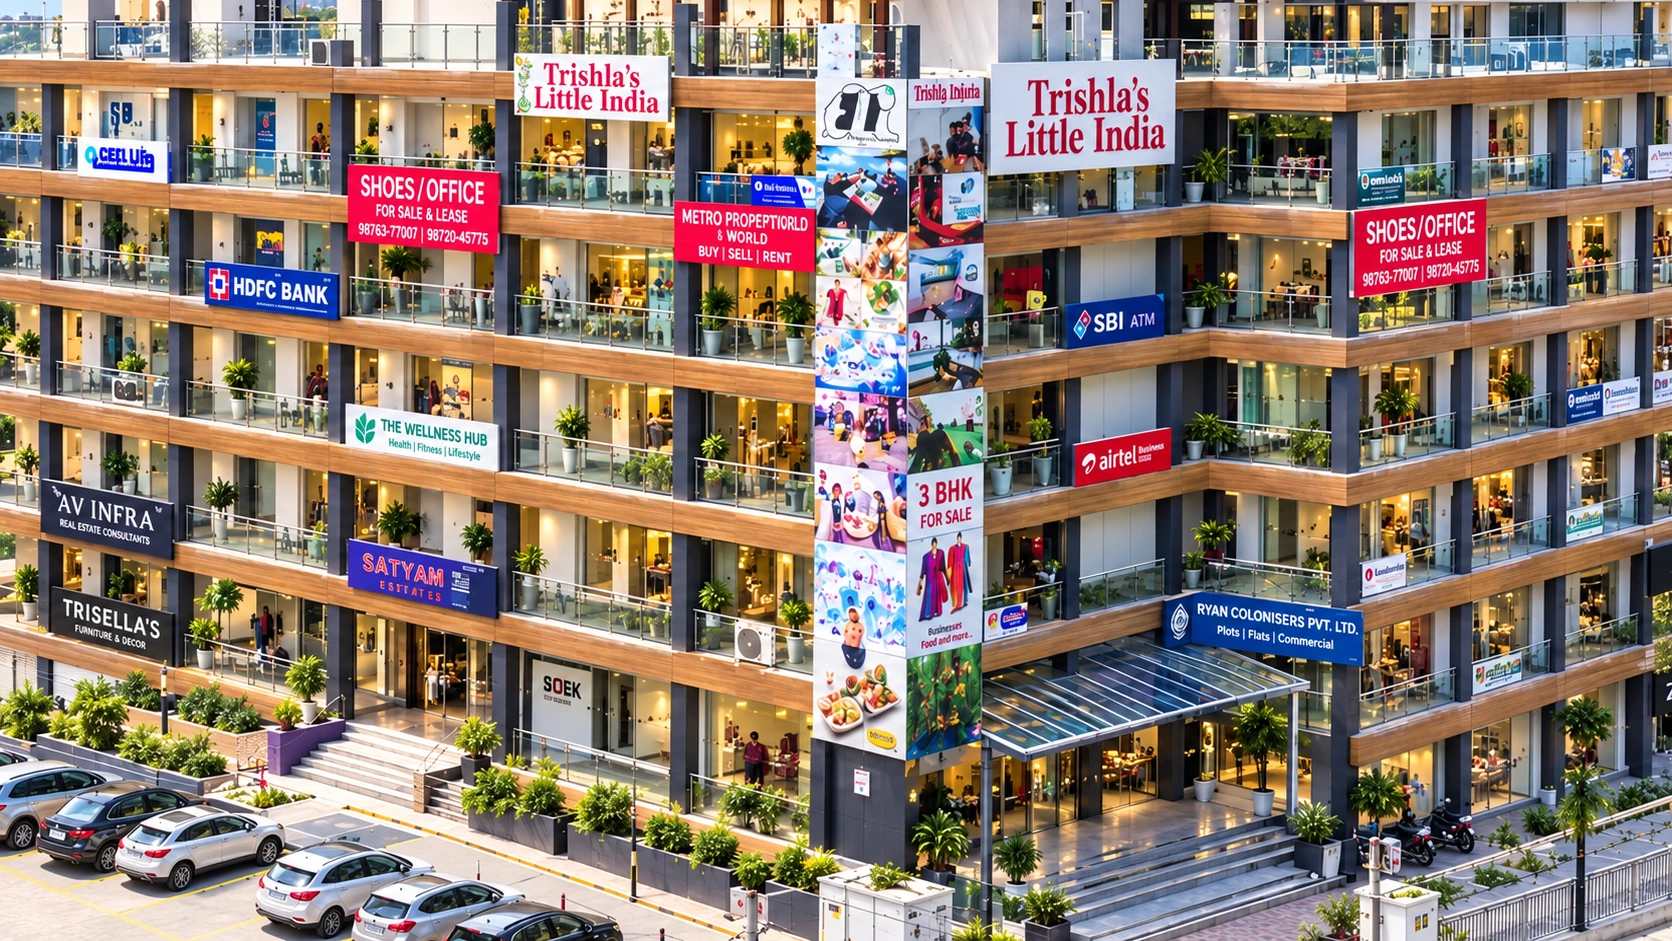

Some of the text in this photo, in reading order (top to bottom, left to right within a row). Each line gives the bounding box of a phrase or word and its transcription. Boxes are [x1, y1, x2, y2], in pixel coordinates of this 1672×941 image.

[544, 62, 640, 88] Trishla's
[534, 86, 660, 114] Little India
[1028, 76, 1149, 117] Trishla's
[1005, 114, 1166, 157] Little India
[360, 174, 415, 200] SHOES
[426, 178, 485, 204] OFFICE
[376, 204, 468, 224] FOR SALE & LEASE
[682, 208, 722, 226] METRO
[358, 222, 418, 240] 98763-77007
[427, 228, 488, 246] 98720-45775
[726, 230, 768, 245] WORLD
[698, 245, 719, 258] BUY
[728, 248, 753, 261] SELL
[763, 250, 792, 264] RENT
[1380, 240, 1462, 264] FOR SALE & LEASE
[1362, 266, 1418, 287] 98763-77007
[1426, 259, 1480, 279] 98720-45775
[234, 276, 328, 305] HDFC BANK
[1094, 311, 1155, 333] SBI ATM
[380, 418, 488, 447] THE WELLNESS HUB
[388, 438, 412, 450] Health
[417, 442, 442, 456] Fitness
[448, 447, 481, 462] Lifestyle
[1099, 445, 1138, 470] airtel
[918, 476, 973, 508] 3 BHK
[58, 494, 154, 532] AV INFRA
[920, 506, 972, 529] FOR SALE
[60, 518, 151, 546] REAL ESTATE CONSULTANTS
[362, 552, 444, 588] SATYAM
[62, 598, 160, 640] TRISELLA'S
[1197, 602, 1359, 636] RYAN COLONISERS PVT. LTD.
[74, 624, 147, 650] FURNITURE & DECOR
[921, 638, 938, 650] Food
[938, 634, 951, 645] and
[1217, 624, 1240, 638] Plots
[1248, 629, 1270, 642] Flats
[1278, 633, 1334, 650] Commercial
[544, 675, 582, 700] SOEK
